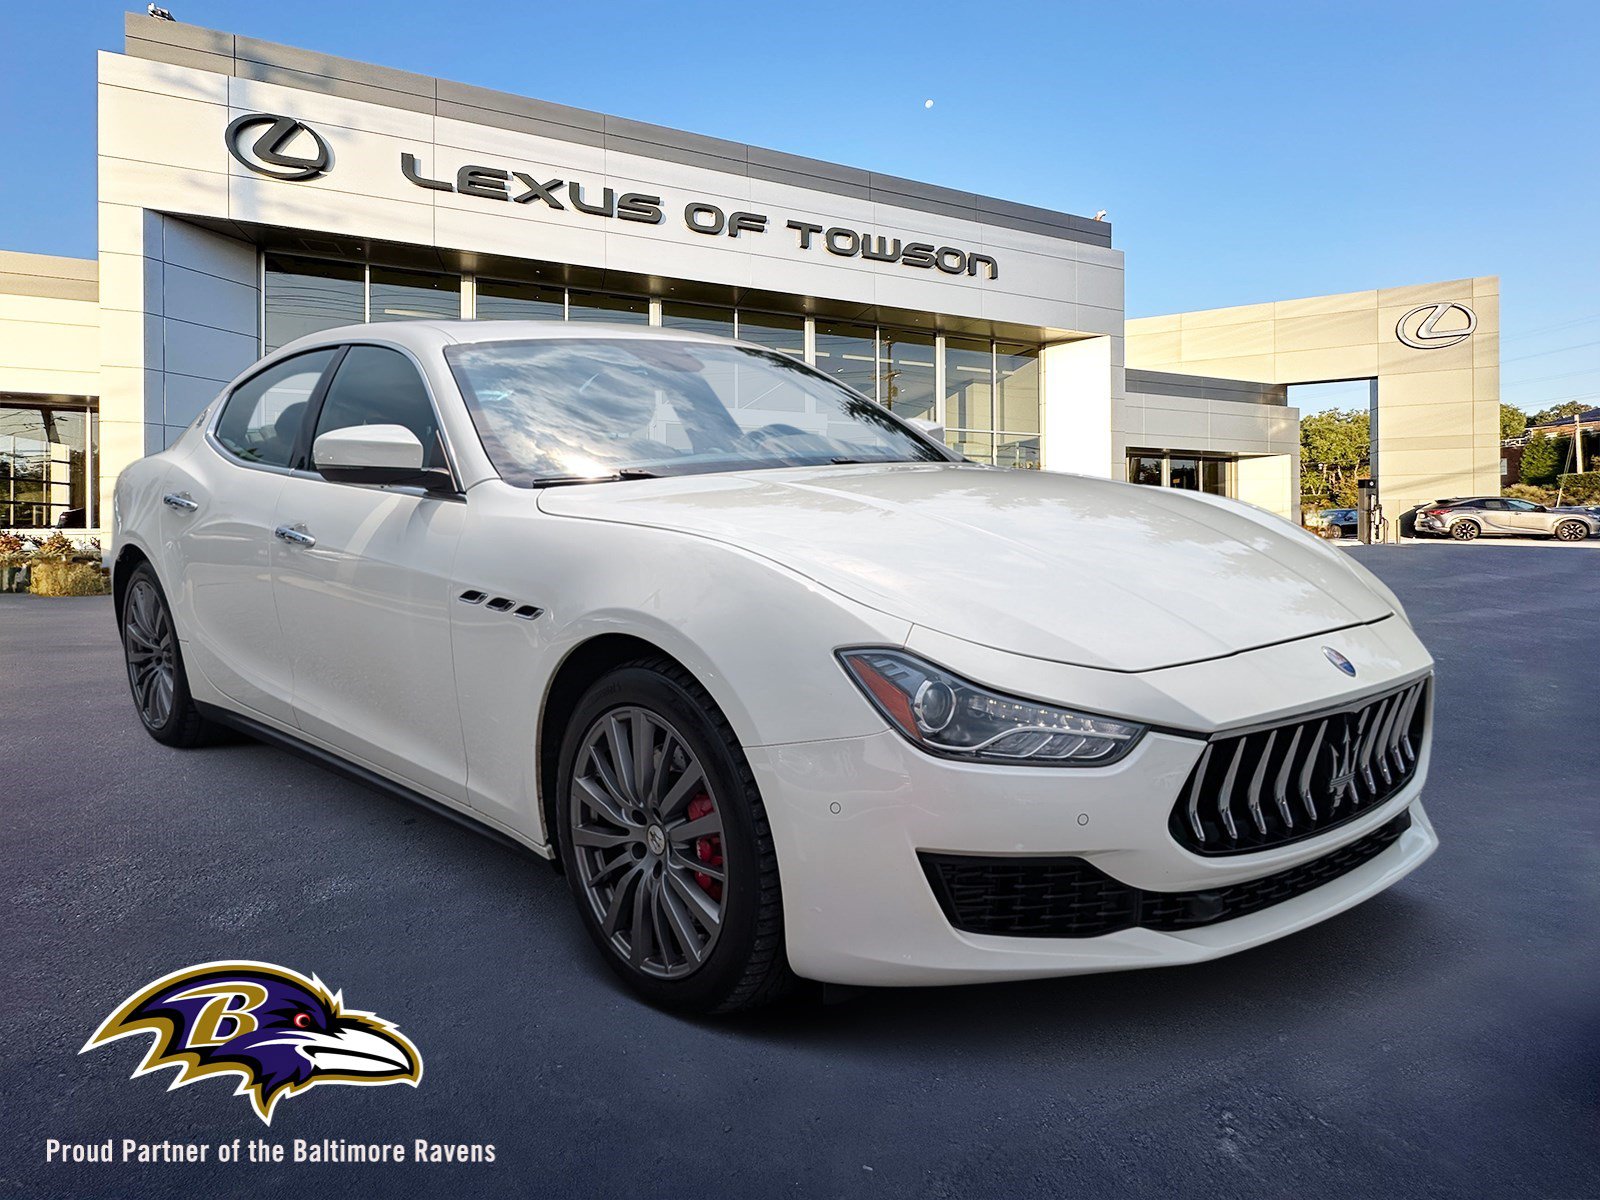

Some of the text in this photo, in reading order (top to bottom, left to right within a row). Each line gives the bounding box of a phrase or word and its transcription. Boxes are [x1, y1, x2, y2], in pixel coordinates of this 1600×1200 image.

[401, 152, 999, 280] LEXUS OF TOWSON
